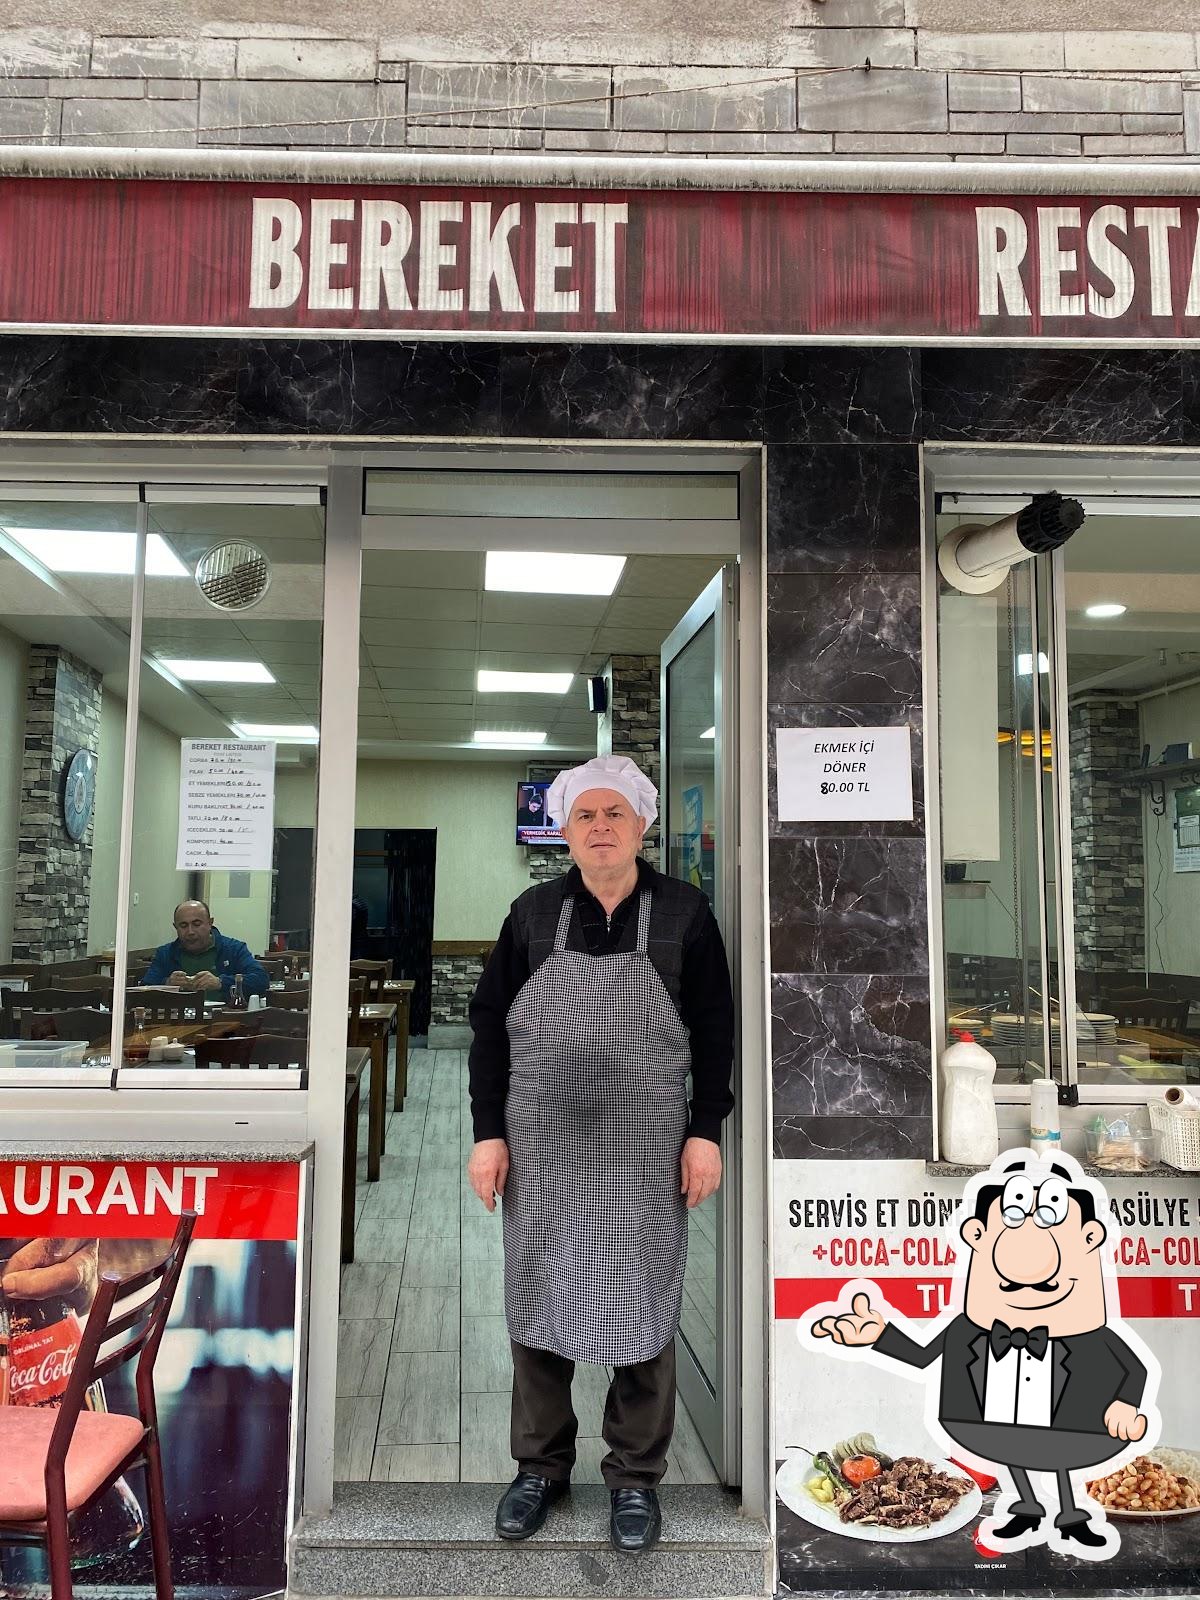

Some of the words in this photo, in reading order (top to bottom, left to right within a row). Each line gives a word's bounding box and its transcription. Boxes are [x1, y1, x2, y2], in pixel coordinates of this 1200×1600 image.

[248, 197, 630, 314] BEREKET
[814, 743, 856, 753] EKMEK
[859, 740, 875, 755] İÇİ
[823, 761, 866, 773] DÖNER
[820, 782, 854, 795] 80.00
[858, 782, 870, 792] TL
[0, 1166, 218, 1216] URANT
[789, 1193, 867, 1228] SERVİS
[876, 1199, 899, 1227] ET
[1109, 1191, 1190, 1227] ASÜLYE
[916, 1284, 954, 1312] TL
[42, 1335, 55, 1345] TAT
